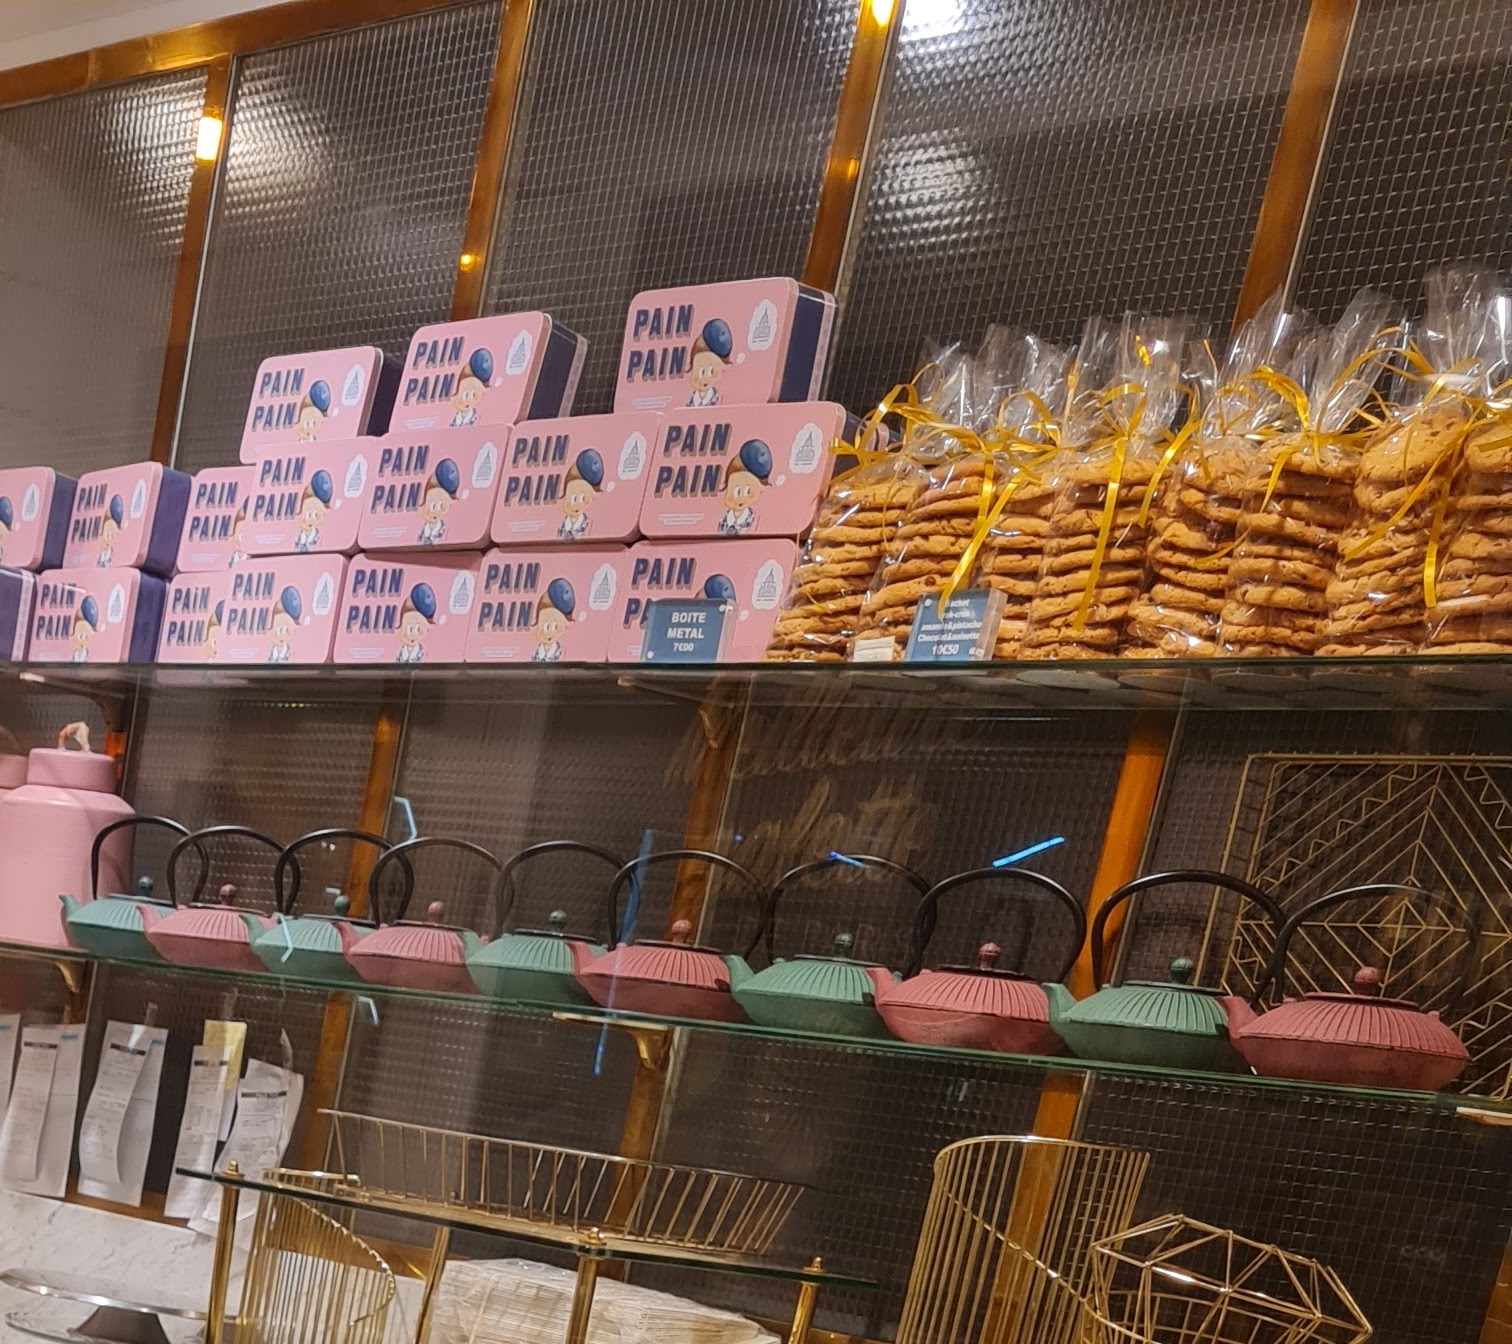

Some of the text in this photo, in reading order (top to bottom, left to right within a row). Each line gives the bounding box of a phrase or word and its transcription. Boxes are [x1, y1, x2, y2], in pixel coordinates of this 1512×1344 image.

[633, 304, 695, 342] PAIN
[412, 336, 465, 371] PAIN
[626, 346, 688, 383] PAIN
[258, 368, 305, 398] PAIN
[403, 373, 456, 406] PAIN
[251, 402, 298, 432] PAIN
[512, 434, 570, 469] PAIN
[663, 423, 732, 458] PAIN
[260, 456, 306, 488] PAIN
[378, 445, 430, 477] PAIN
[195, 481, 239, 509] PAIN
[504, 473, 562, 507] PAIN
[654, 463, 723, 499] PAIN
[76, 483, 108, 512] PAIN
[252, 492, 299, 523] PAIN
[371, 482, 423, 514] PAIN
[71, 515, 102, 544] PAIN
[189, 515, 232, 543] PAIN
[232, 572, 275, 600] PAIN
[352, 568, 404, 598] PAIN
[484, 562, 541, 594] PAIN
[631, 557, 697, 590] PAIN
[40, 583, 77, 608] PAIN
[172, 587, 211, 615] PAIN
[36, 615, 72, 640] PAIN
[226, 607, 270, 636] PAIN
[346, 604, 398, 634] PAIN
[478, 601, 534, 633] PAIN
[671, 612, 706, 623] BOITE
[167, 620, 206, 647] PAIN
[667, 628, 704, 639] METAL
